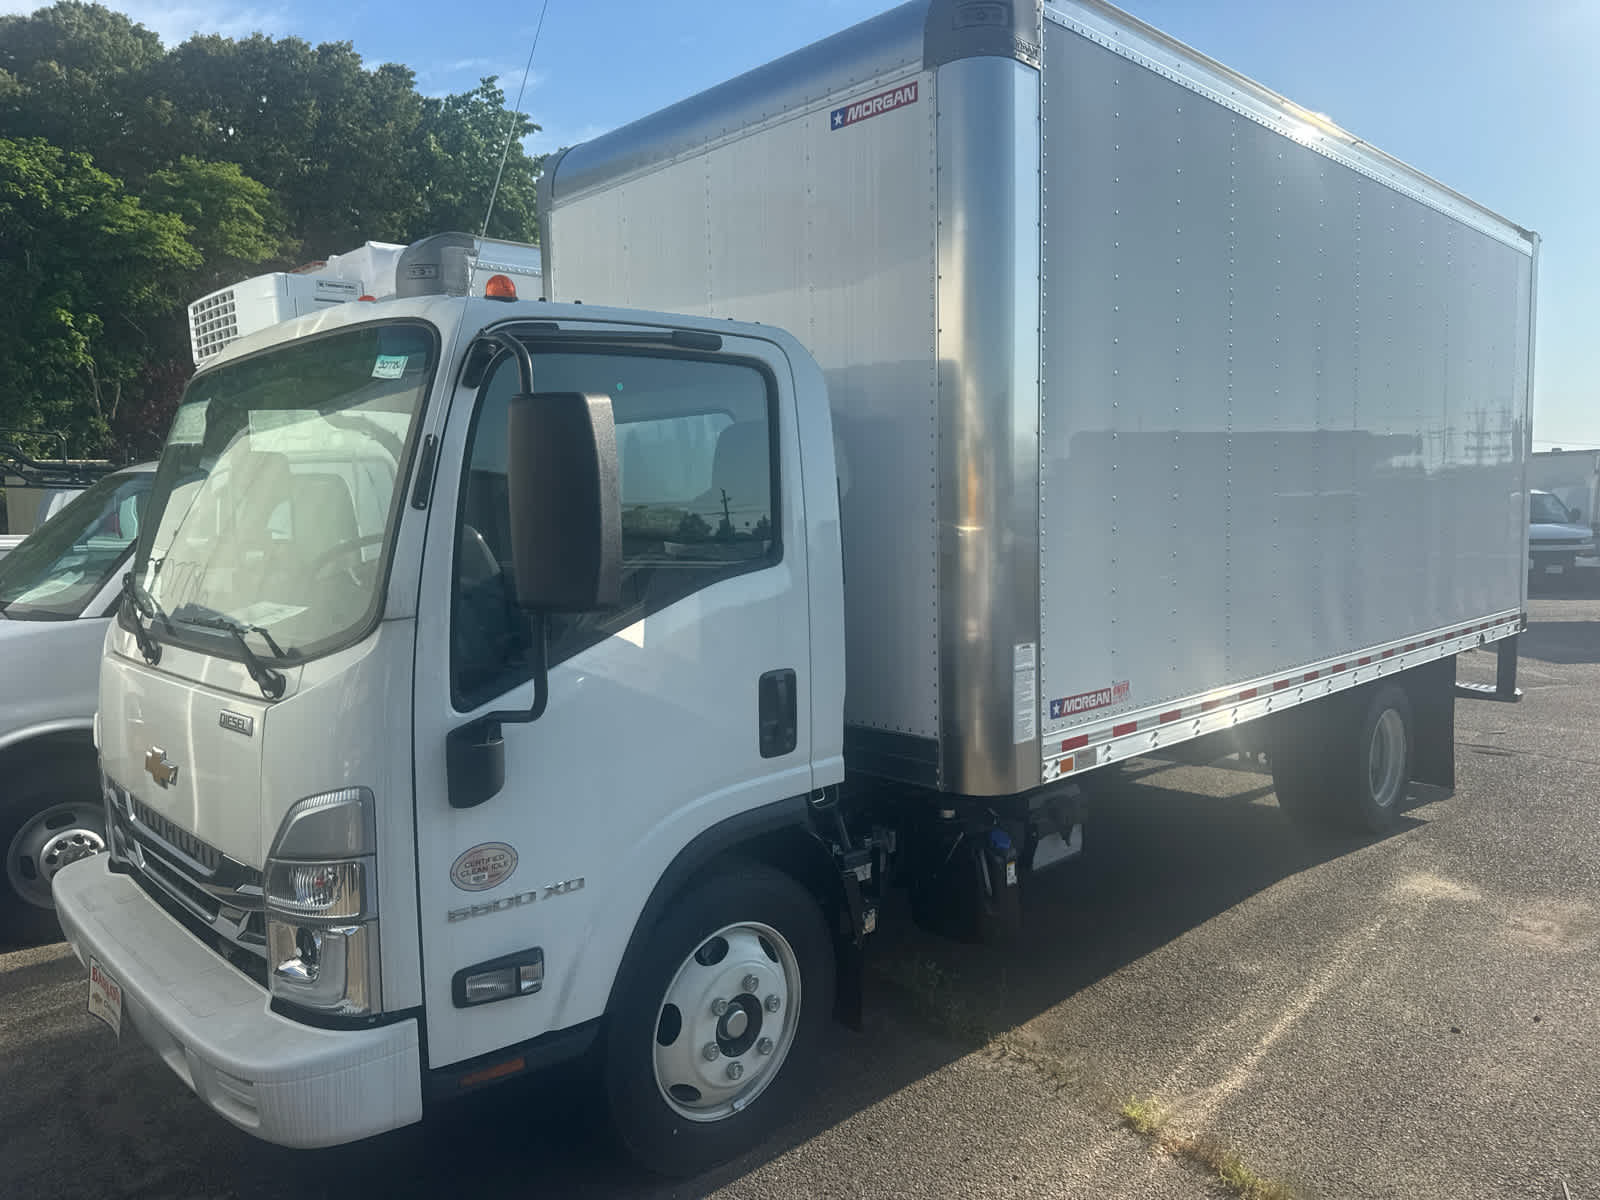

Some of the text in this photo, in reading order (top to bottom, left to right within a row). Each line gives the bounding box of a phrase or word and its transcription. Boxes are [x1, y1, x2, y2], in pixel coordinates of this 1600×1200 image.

[847, 85, 916, 122] MORGAN
[1063, 690, 1111, 713] MORGAN
[220, 712, 248, 731] DIESEL
[460, 866, 489, 878] CLEAN
[491, 860, 509, 873] IDLE
[464, 854, 505, 869] CERTIFIED
